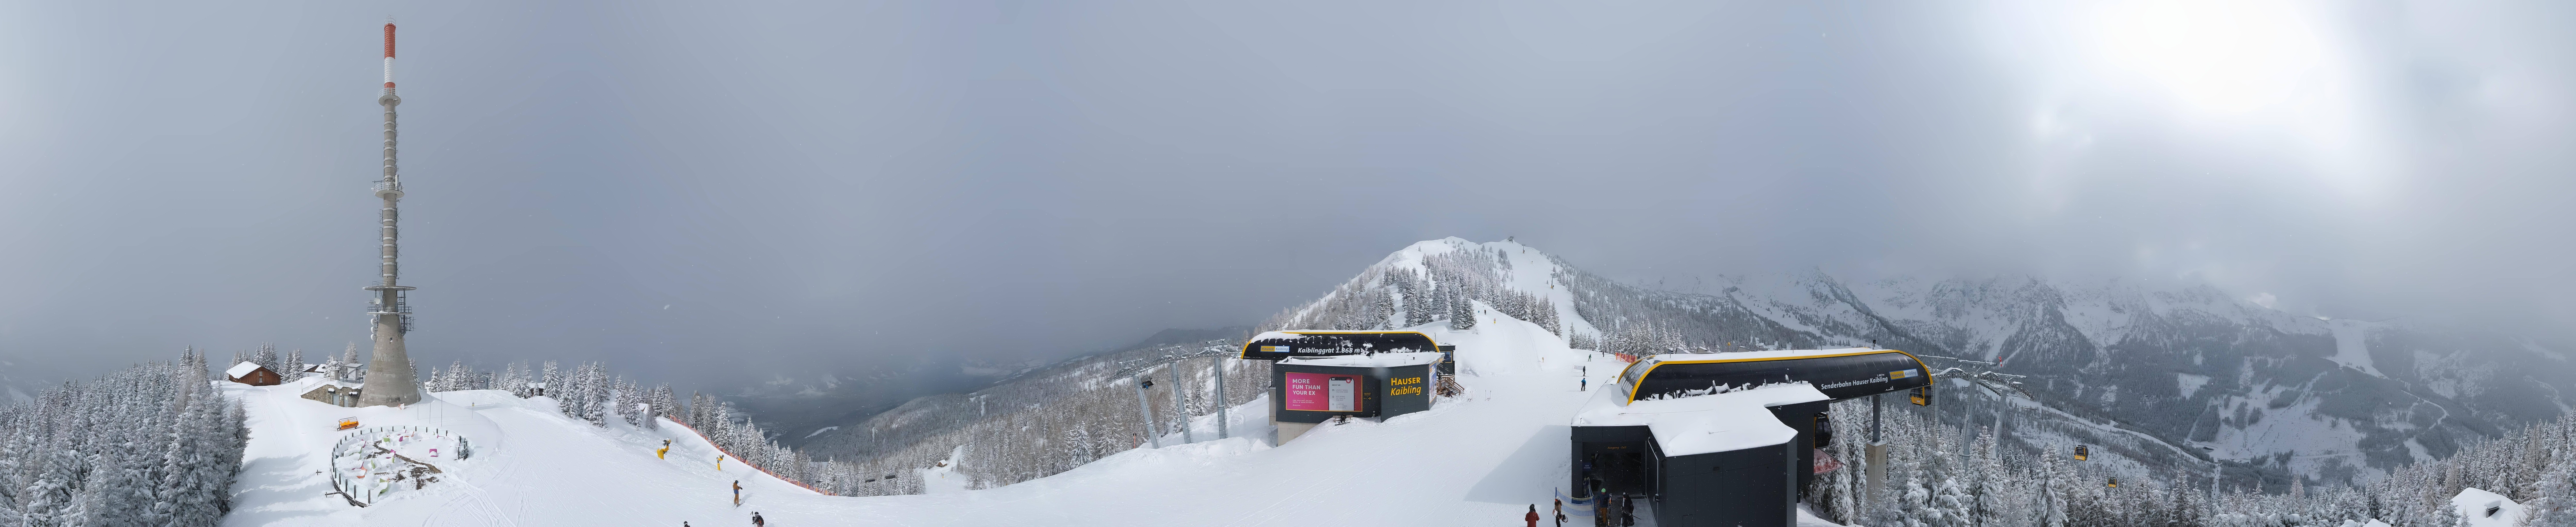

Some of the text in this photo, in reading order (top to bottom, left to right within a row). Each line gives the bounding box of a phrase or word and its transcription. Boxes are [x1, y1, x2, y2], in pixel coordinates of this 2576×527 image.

[1391, 377, 1421, 386] HAUSER
[1821, 381, 1851, 390] Senderbahn
[1391, 386, 1421, 396] Kaibling
